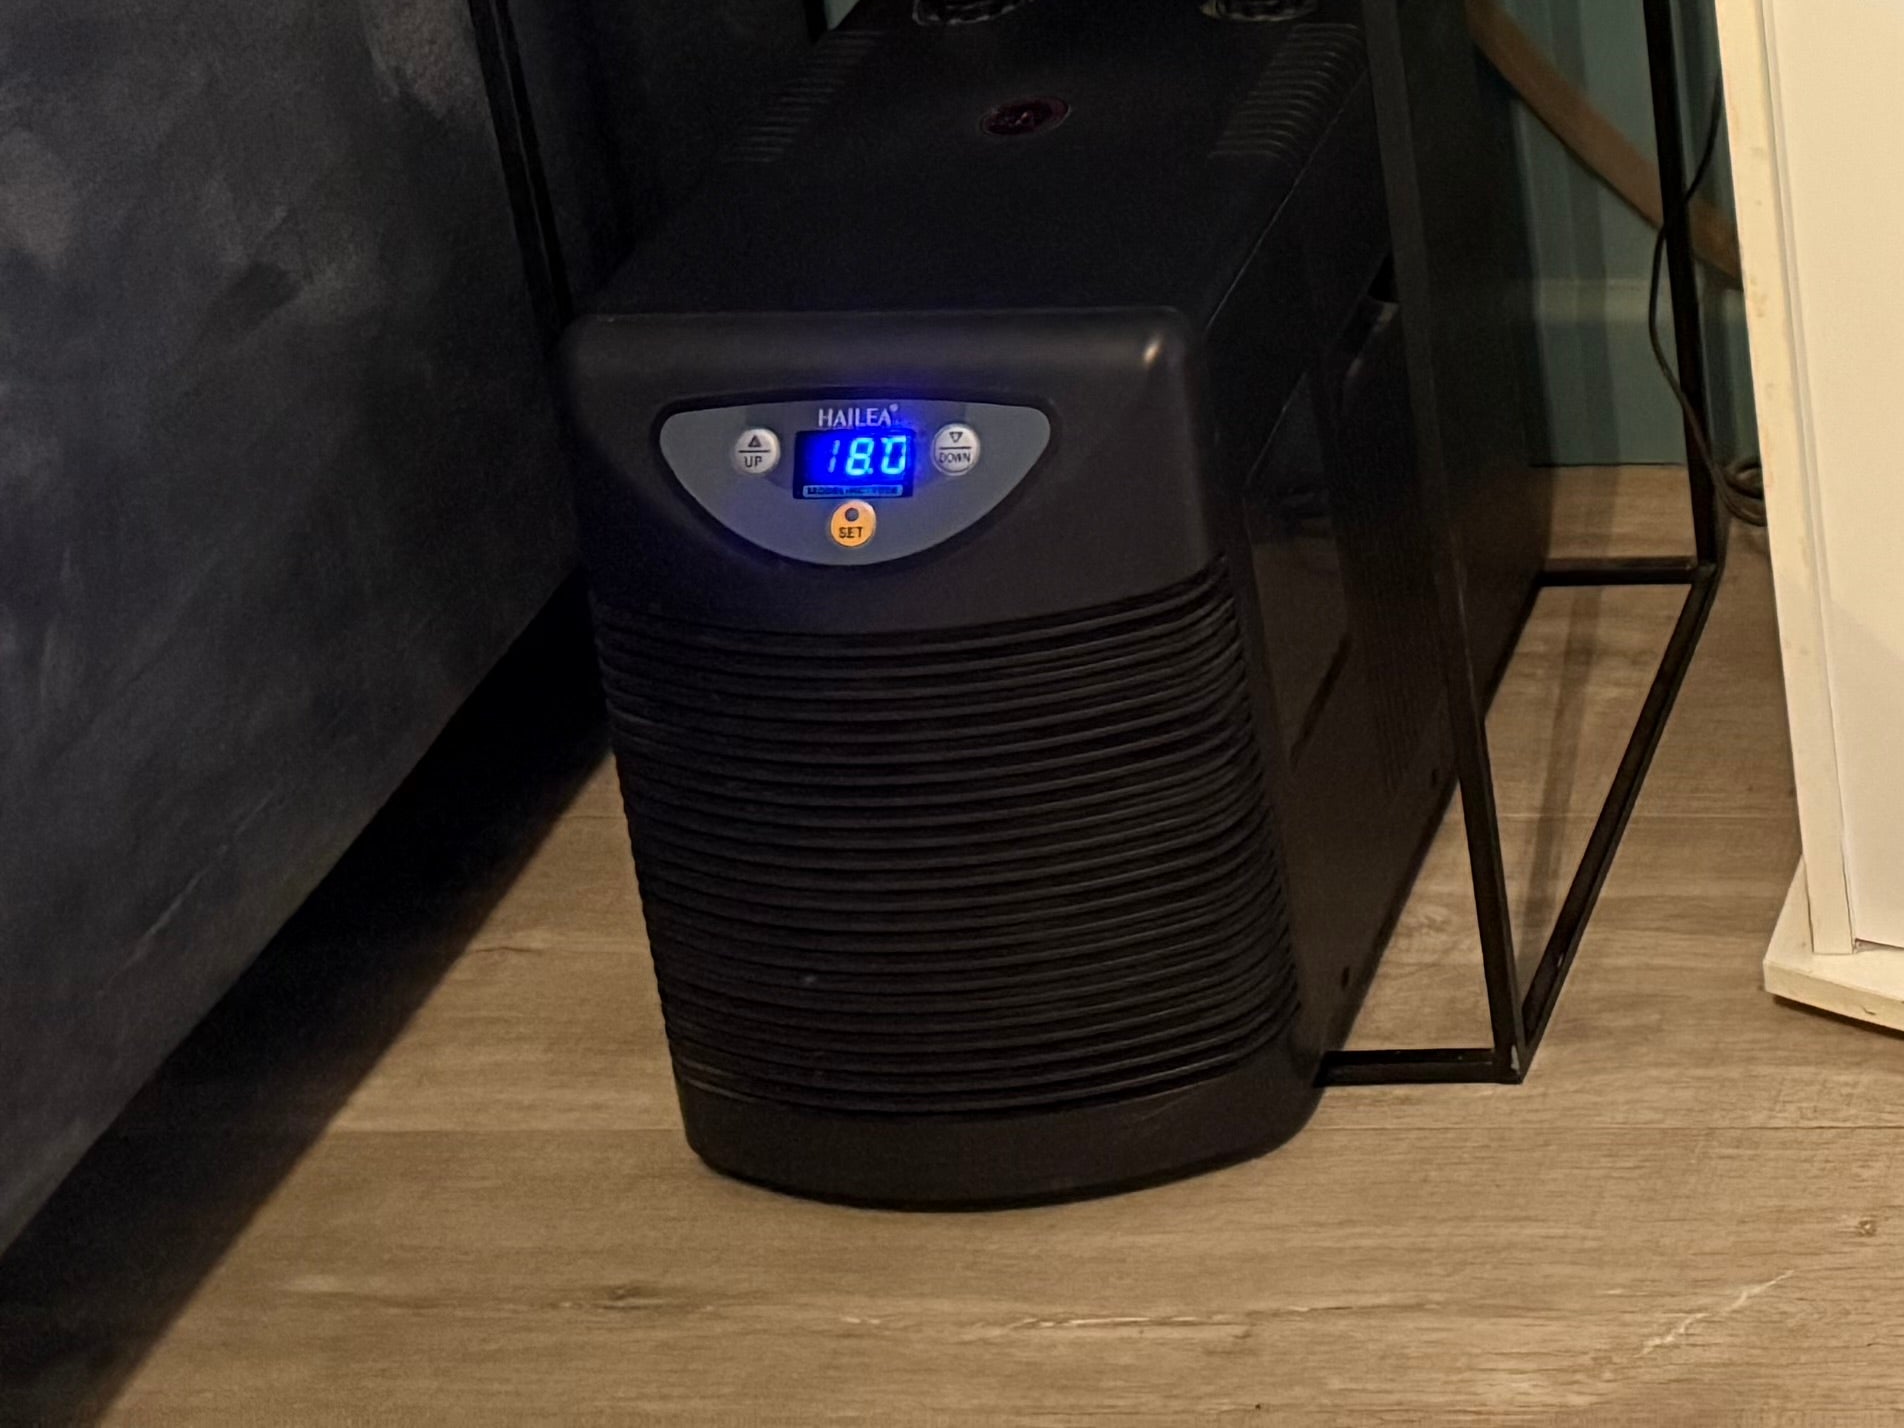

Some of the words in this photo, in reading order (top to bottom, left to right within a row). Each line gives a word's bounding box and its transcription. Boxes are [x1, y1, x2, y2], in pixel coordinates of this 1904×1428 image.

[818, 407, 892, 427] HAILEA
[743, 454, 763, 469] UP
[827, 435, 907, 476] 18.0
[938, 452, 971, 464] DOWN
[838, 526, 863, 539] SET
